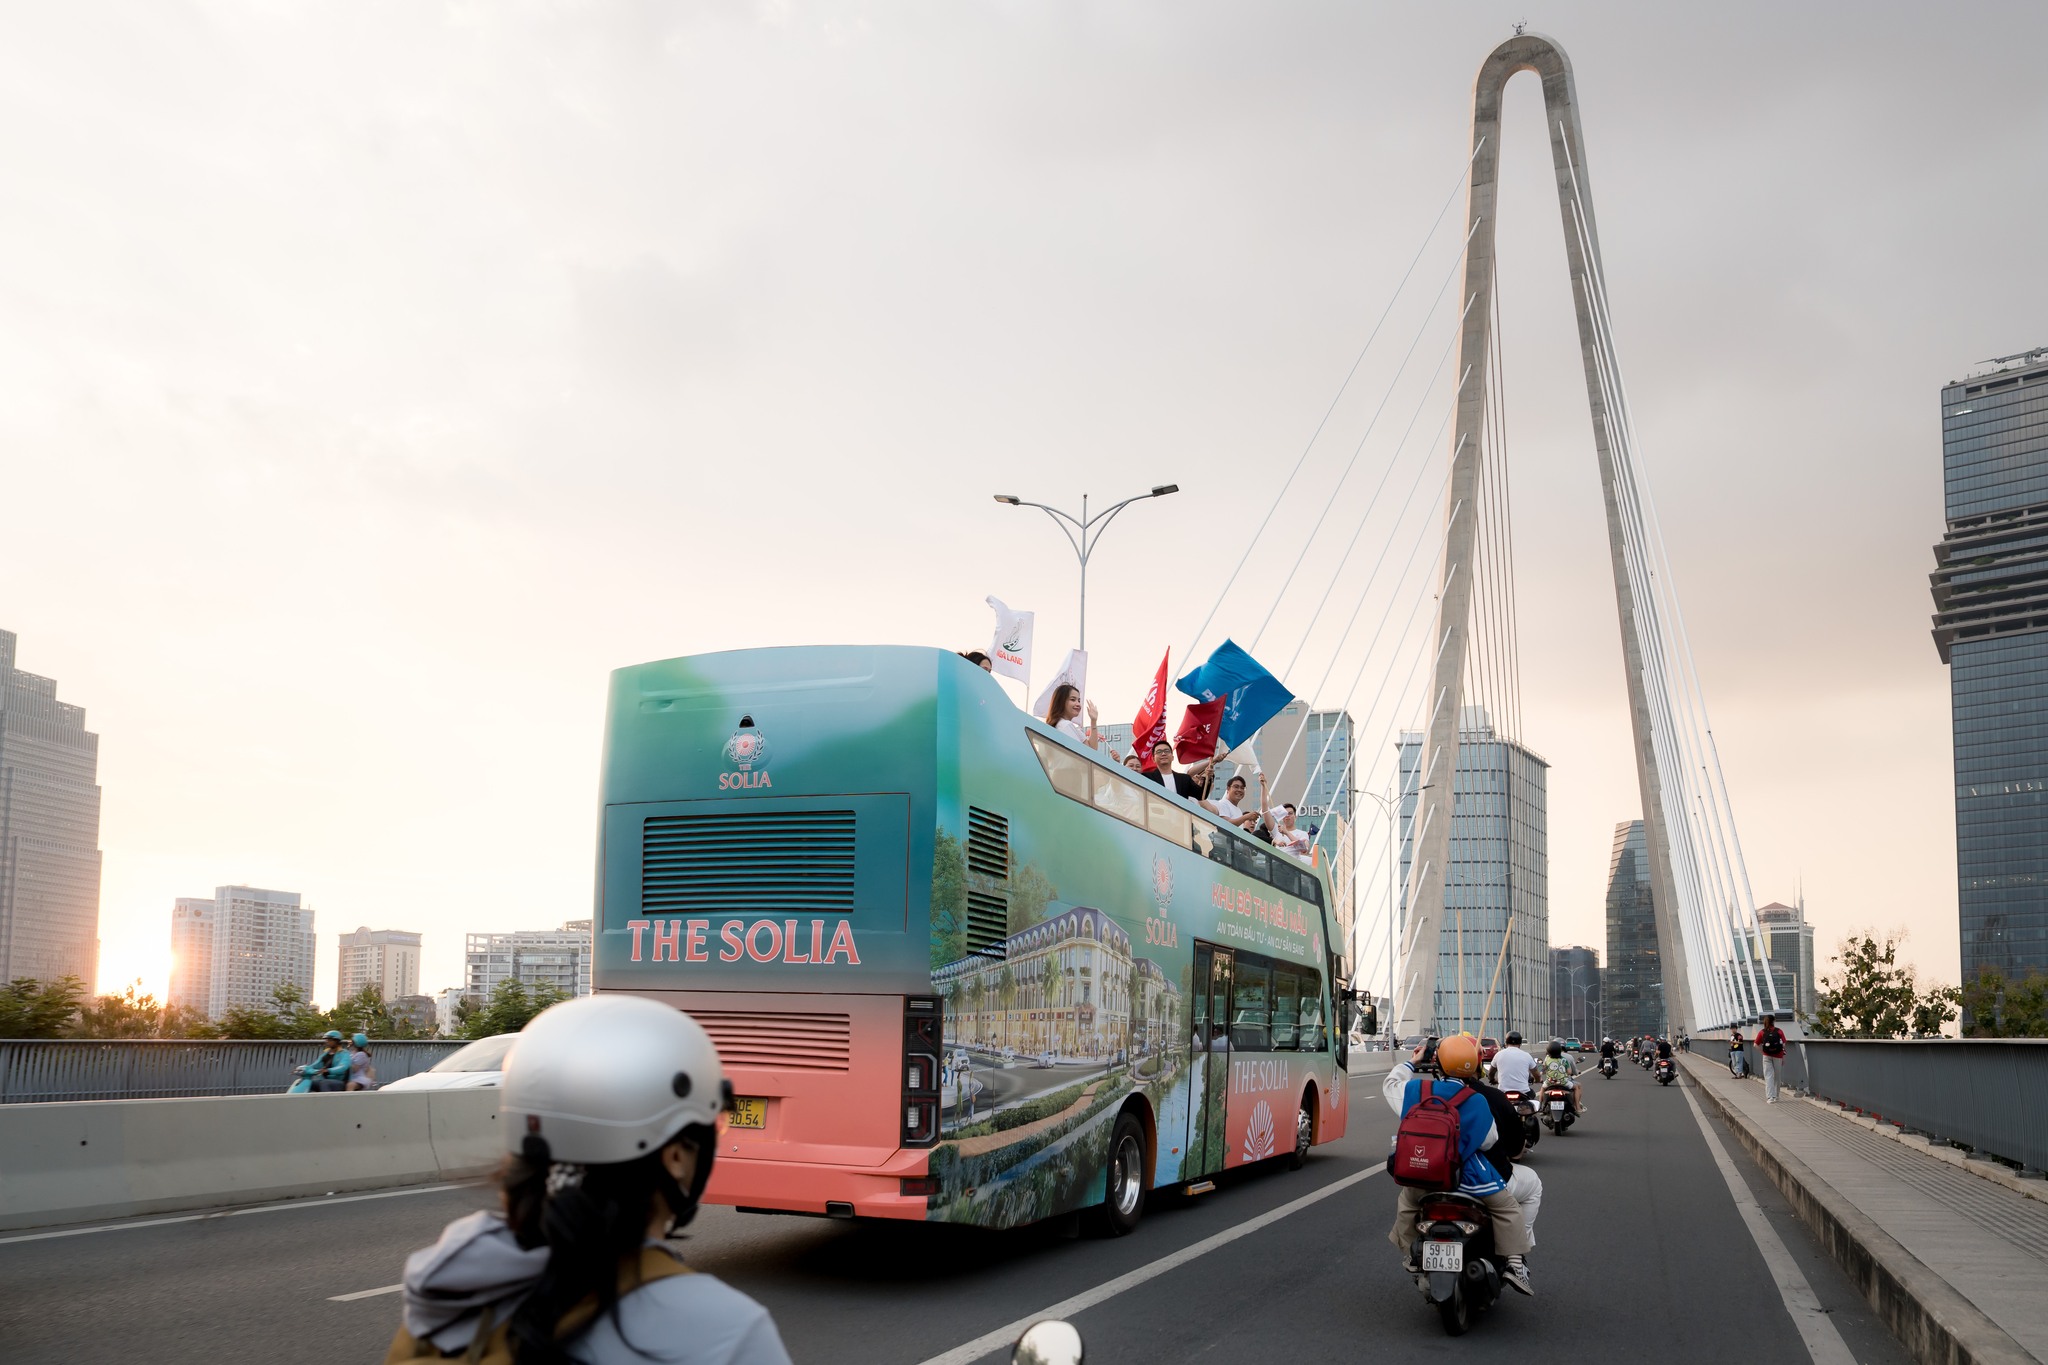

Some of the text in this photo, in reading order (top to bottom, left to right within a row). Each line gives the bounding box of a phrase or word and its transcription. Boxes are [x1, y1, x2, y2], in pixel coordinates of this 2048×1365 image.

[1006, 654, 1023, 666] LAND
[719, 771, 772, 790] SOLIA
[1211, 881, 1235, 912] KHU
[1253, 896, 1269, 929] THỊ
[627, 919, 861, 964] THE SOLIA
[1145, 916, 1178, 949] SOLIA
[1216, 921, 1227, 935] AN
[1227, 922, 1244, 938] TOÀN
[1267, 935, 1275, 948] AN
[1234, 1059, 1289, 1094] THE SOLIA
[1425, 1257, 1460, 1270] 604.99
[1429, 1244, 1456, 1257] 59-D1
